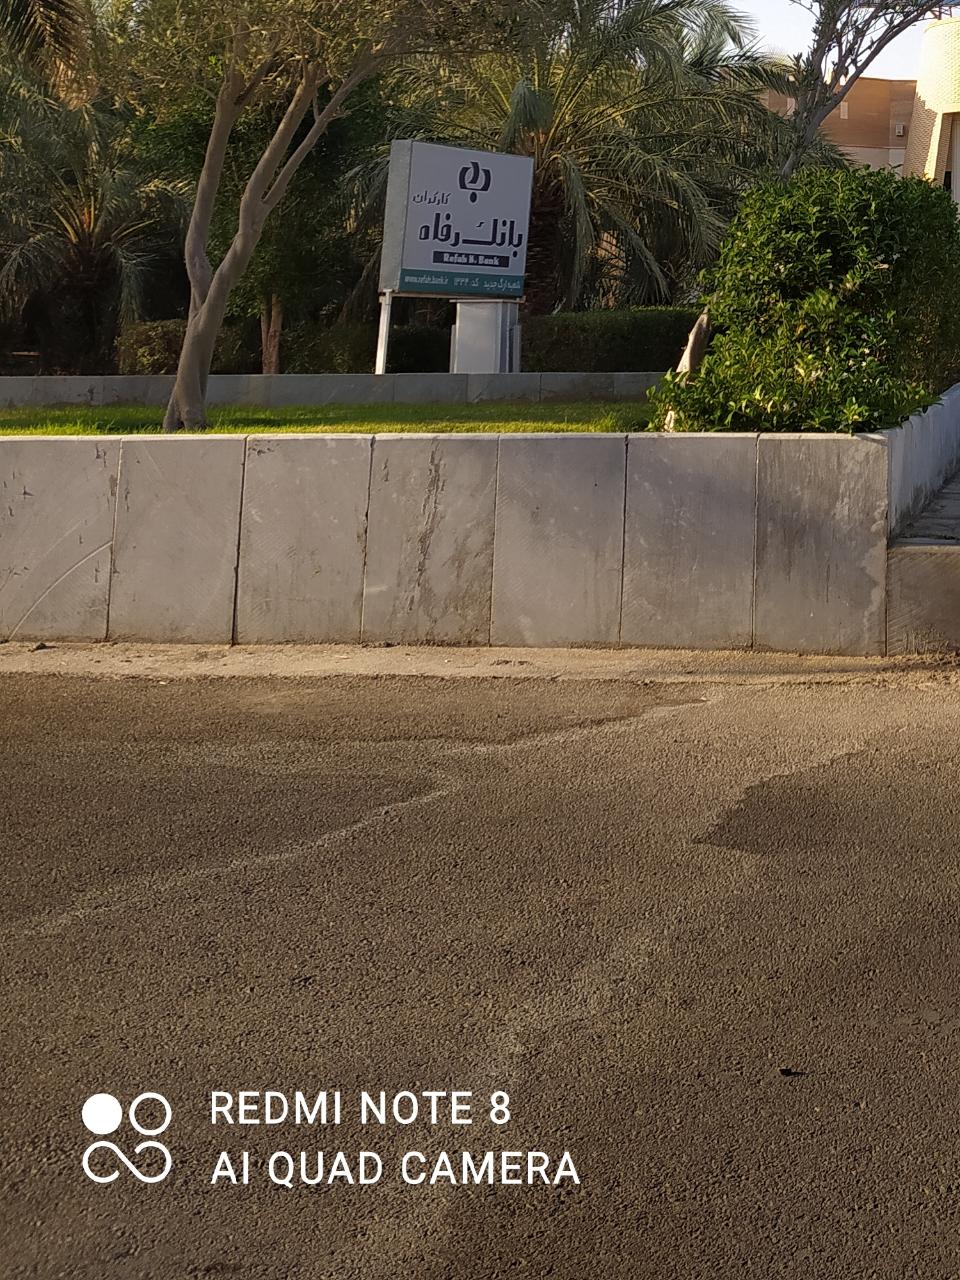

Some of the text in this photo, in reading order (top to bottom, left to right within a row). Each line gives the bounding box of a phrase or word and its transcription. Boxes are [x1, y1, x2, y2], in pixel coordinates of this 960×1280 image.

[418, 212, 524, 258] بانک رفاه
[478, 255, 500, 266] Bank
